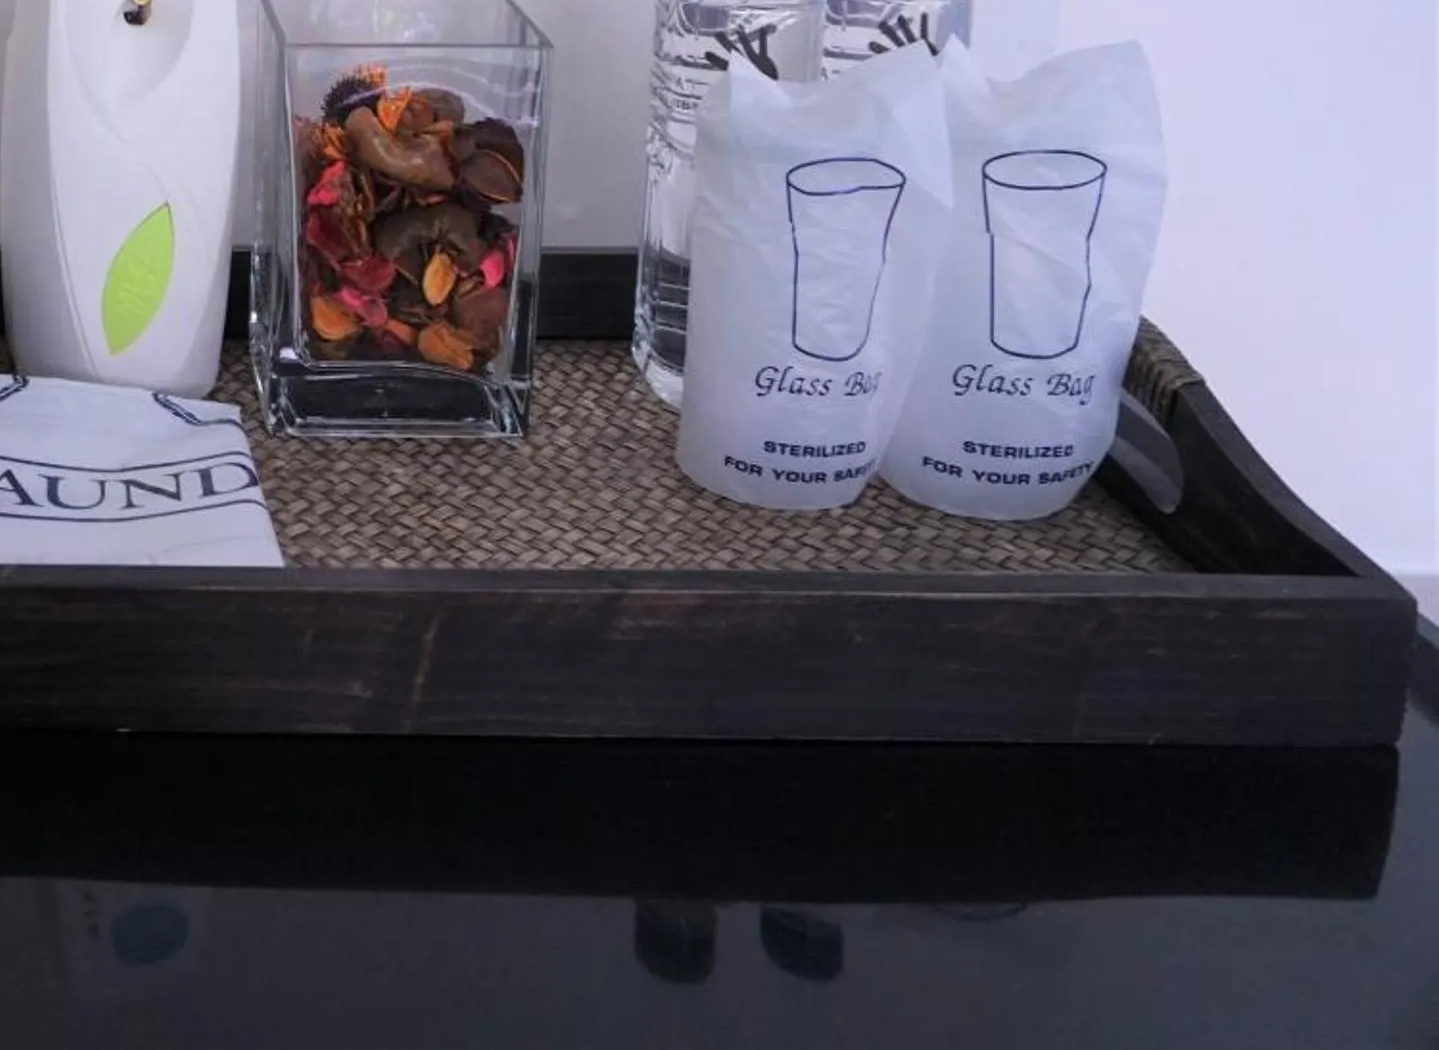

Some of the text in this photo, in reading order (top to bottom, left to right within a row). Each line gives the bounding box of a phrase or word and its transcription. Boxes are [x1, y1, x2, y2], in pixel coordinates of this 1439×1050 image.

[755, 366, 833, 397] Glass
[952, 363, 1096, 406] Glass Bag
[763, 440, 867, 458] STERILIZED
[962, 440, 1074, 460] STERILIZED
[724, 455, 763, 477] FOR
[772, 469, 827, 484] YOUR
[922, 456, 1094, 486] FOR YOUR SAFETY
